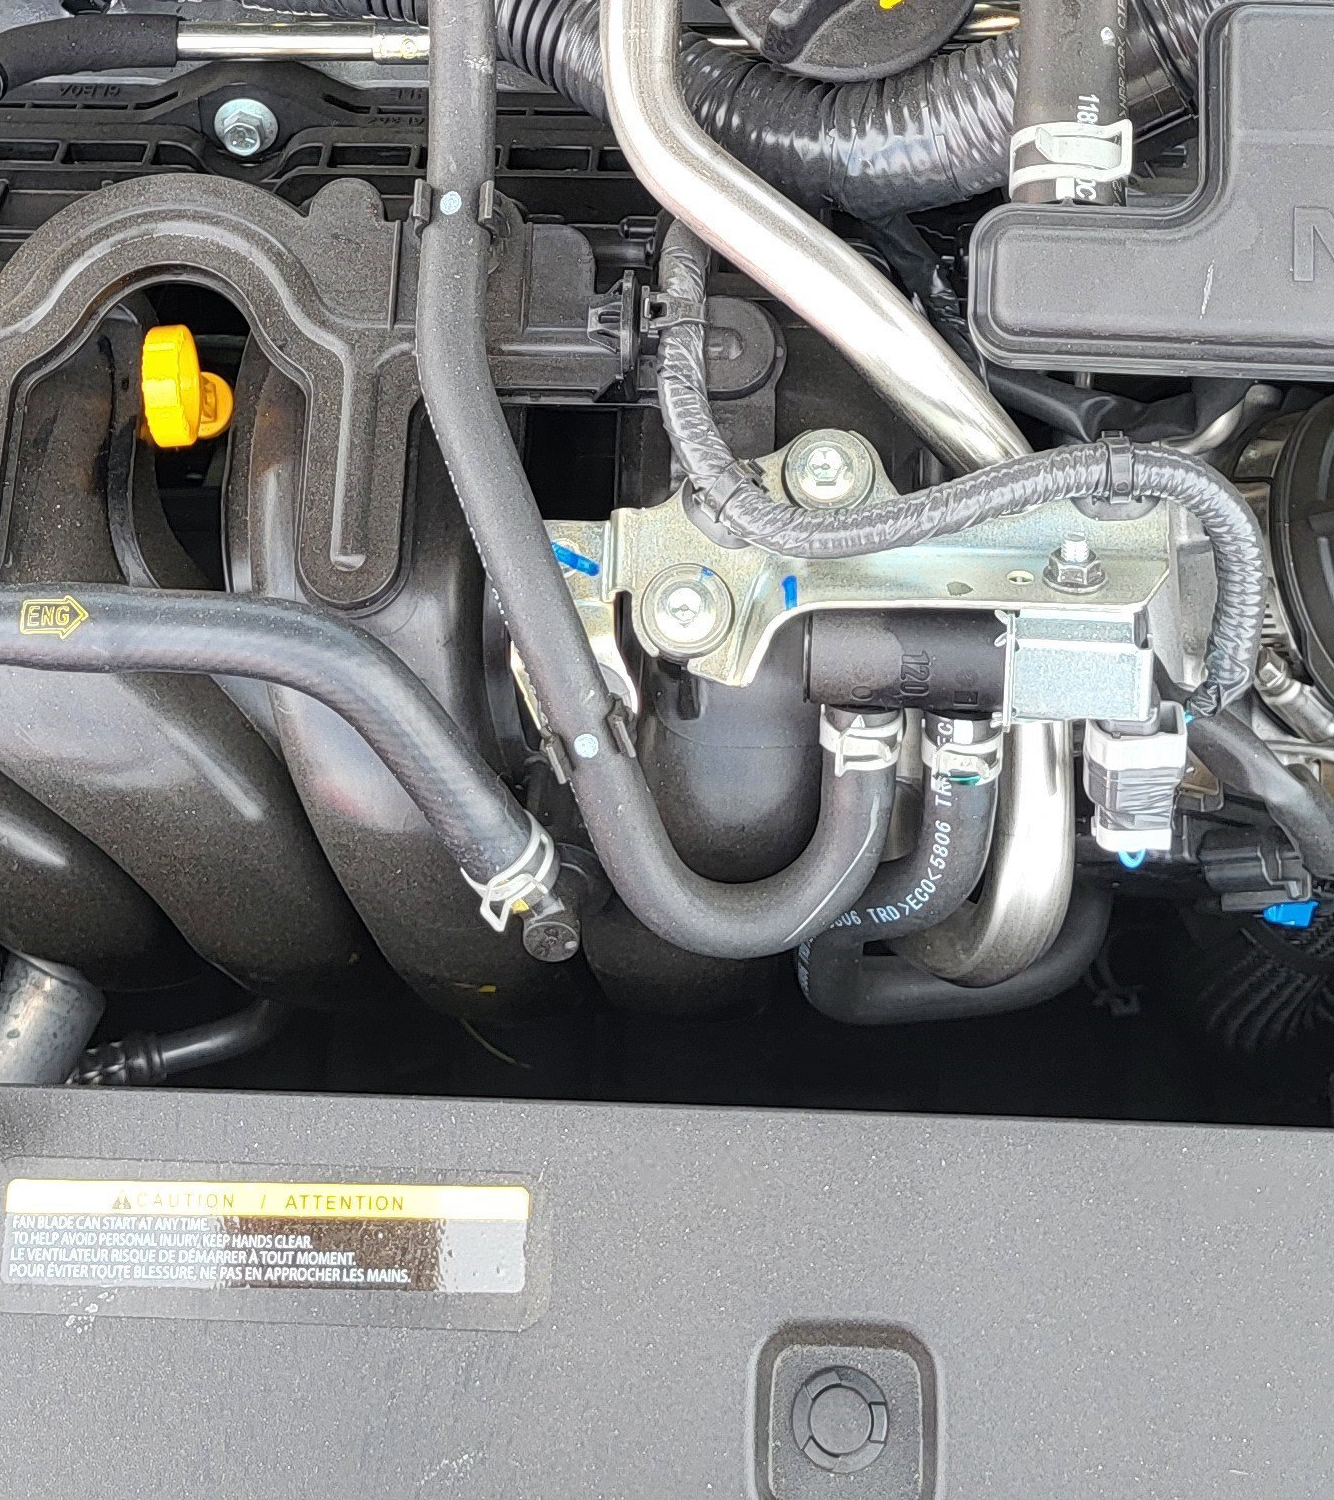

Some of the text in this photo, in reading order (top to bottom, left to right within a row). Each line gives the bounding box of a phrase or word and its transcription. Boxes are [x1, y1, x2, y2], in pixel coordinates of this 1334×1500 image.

[25, 602, 71, 629] ENG
[136, 1193, 234, 1209] CAUTION
[286, 1195, 403, 1211] ATTENTION
[12, 1216, 209, 1231] FAN BLADE CAN START AT ANY TIME.
[12, 1232, 313, 1249] TO HELP AVOID PERSONAL INJURY, KEEP HANDS CLEAR.
[10, 1247, 356, 1266] LE VENTILATEUR RISQUE DE DÉMARRER À TOUT MOMENT.
[9, 1262, 411, 1282] POUR ÉVITER TOUTE BLESSURE, NE PAS EN APPROCHER LES MAINS.
